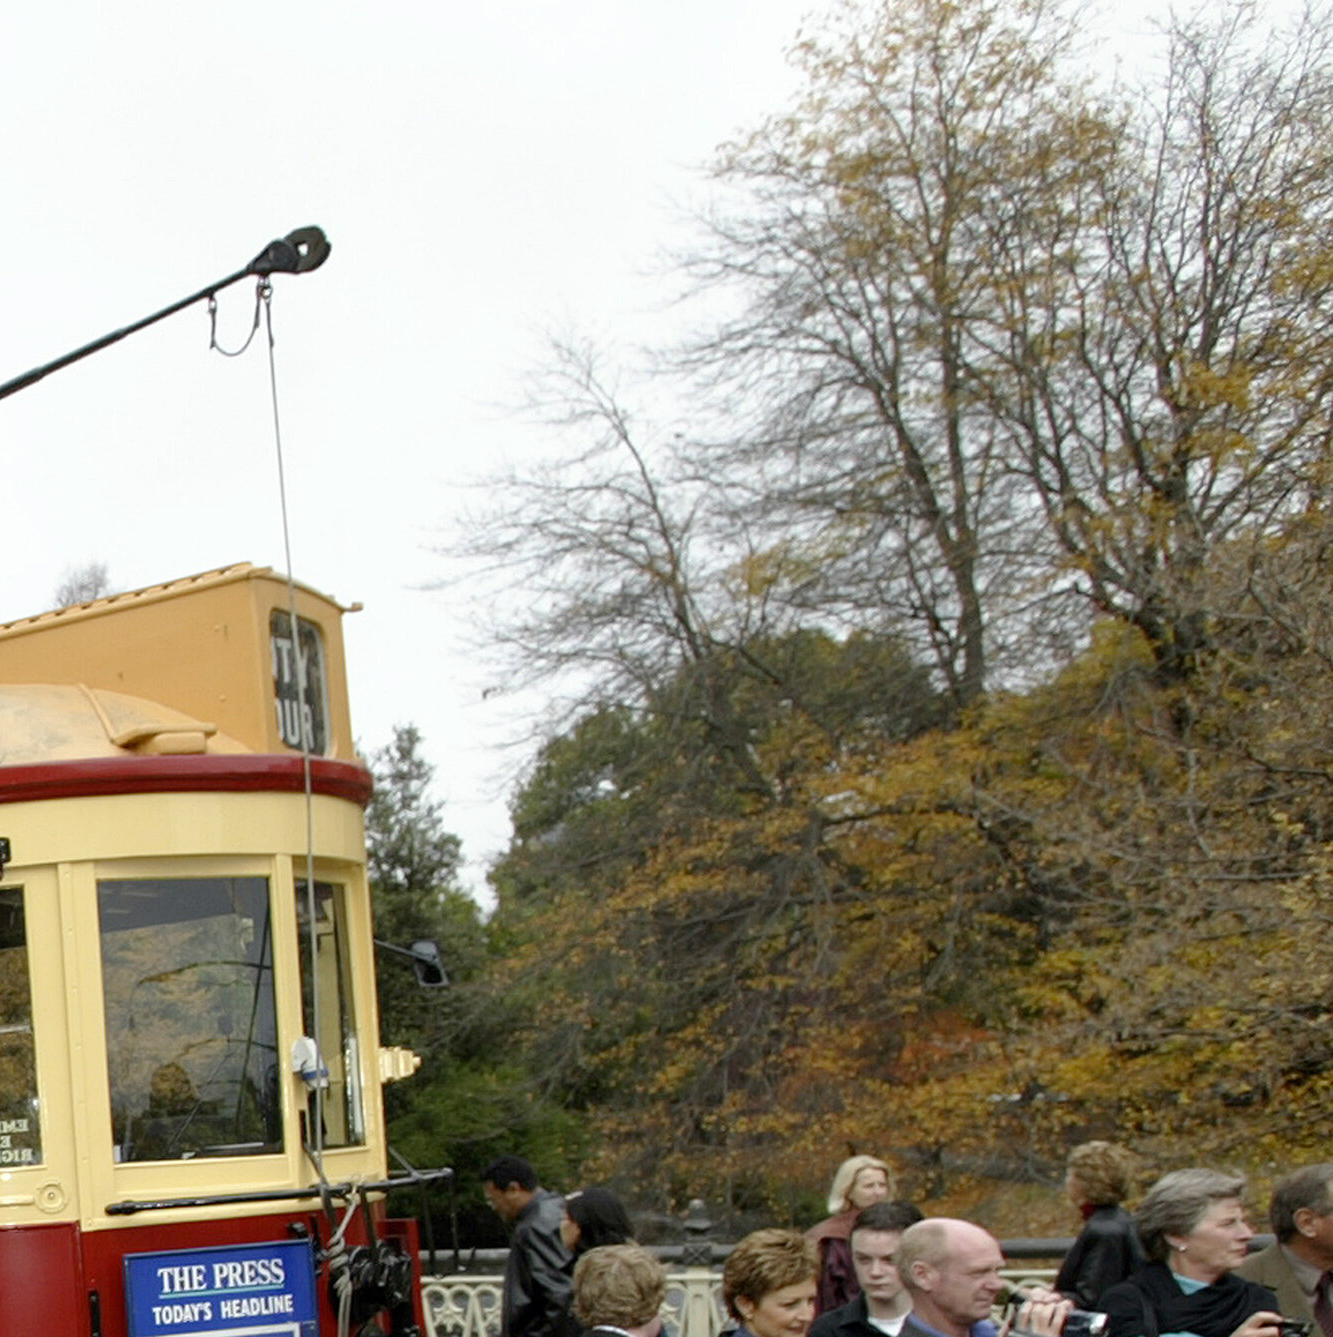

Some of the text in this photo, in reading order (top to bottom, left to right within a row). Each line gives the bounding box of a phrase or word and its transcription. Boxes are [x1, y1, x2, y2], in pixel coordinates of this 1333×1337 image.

[158, 1258, 285, 1294] THE PRESS
[152, 1294, 294, 1325] TODAY'S HEADLINE
